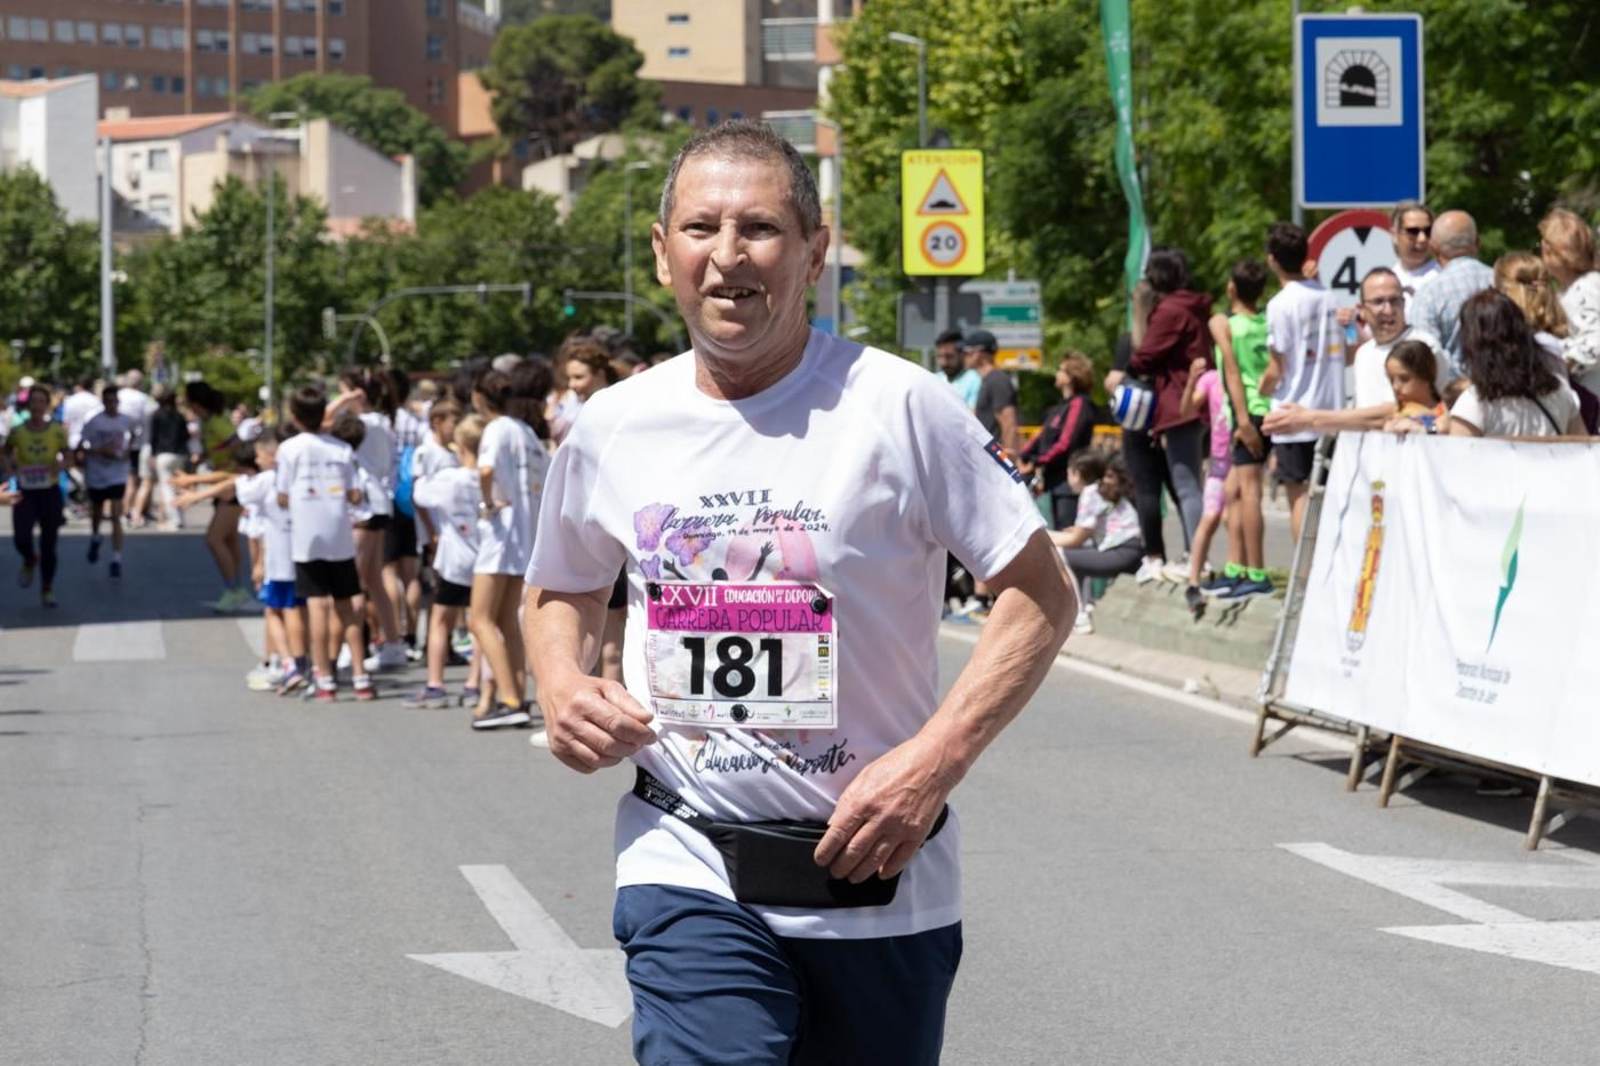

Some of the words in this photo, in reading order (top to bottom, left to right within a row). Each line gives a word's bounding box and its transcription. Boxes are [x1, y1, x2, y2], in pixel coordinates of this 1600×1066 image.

[932, 235, 957, 250] 20
[1331, 255, 1362, 294] 4
[699, 488, 772, 508] XXVII
[738, 527, 749, 536] de
[784, 523, 794, 532] de
[724, 587, 774, 604] EDUCACIÓN
[785, 588, 818, 604] DEPOR
[656, 607, 732, 631] CARRERA
[738, 608, 823, 632] POPULAR
[683, 636, 783, 698] 181
